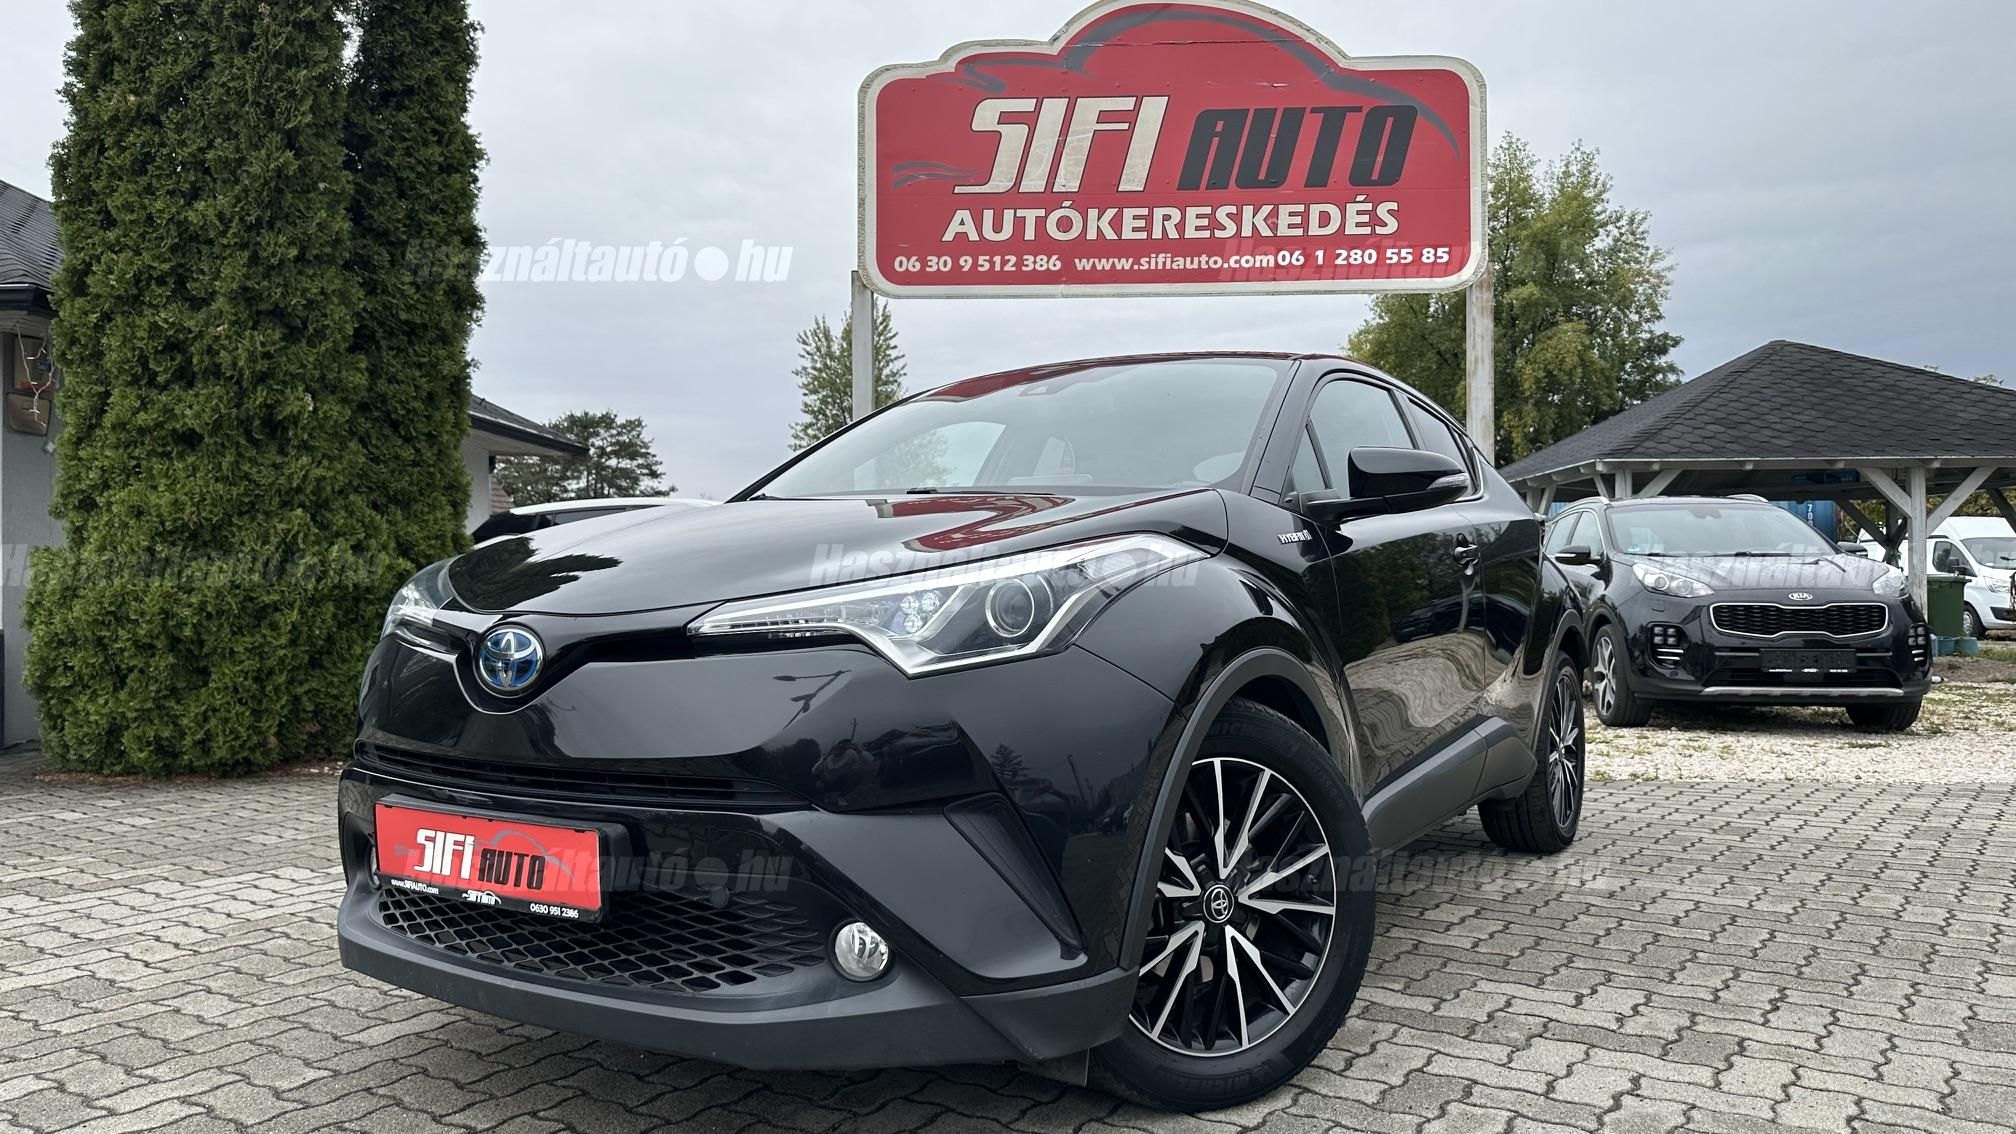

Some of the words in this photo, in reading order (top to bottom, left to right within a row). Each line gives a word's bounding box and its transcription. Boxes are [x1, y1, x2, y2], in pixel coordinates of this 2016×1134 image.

[953, 95, 1170, 194] SIFI
[1176, 104, 1419, 191] AUTO
[940, 194, 1400, 242] AUTÓKERESKEDÉS
[894, 255, 921, 272] 06
[925, 255, 952, 272] 30
[1021, 254, 1062, 271] 386
[1074, 252, 1275, 271] www.sifiauto.com
[1276, 250, 1305, 267] 06
[1314, 250, 1325, 265] 1
[1334, 249, 1377, 265] 280
[1385, 248, 1413, 264] 55
[1421, 247, 1450, 263] 85
[1789, 592, 1812, 600] KIA
[413, 828, 475, 881] SIFI
[477, 847, 546, 891] AUTO
[530, 902, 548, 914] 0630
[549, 905, 561, 917] 951
[561, 907, 579, 919] 2386
